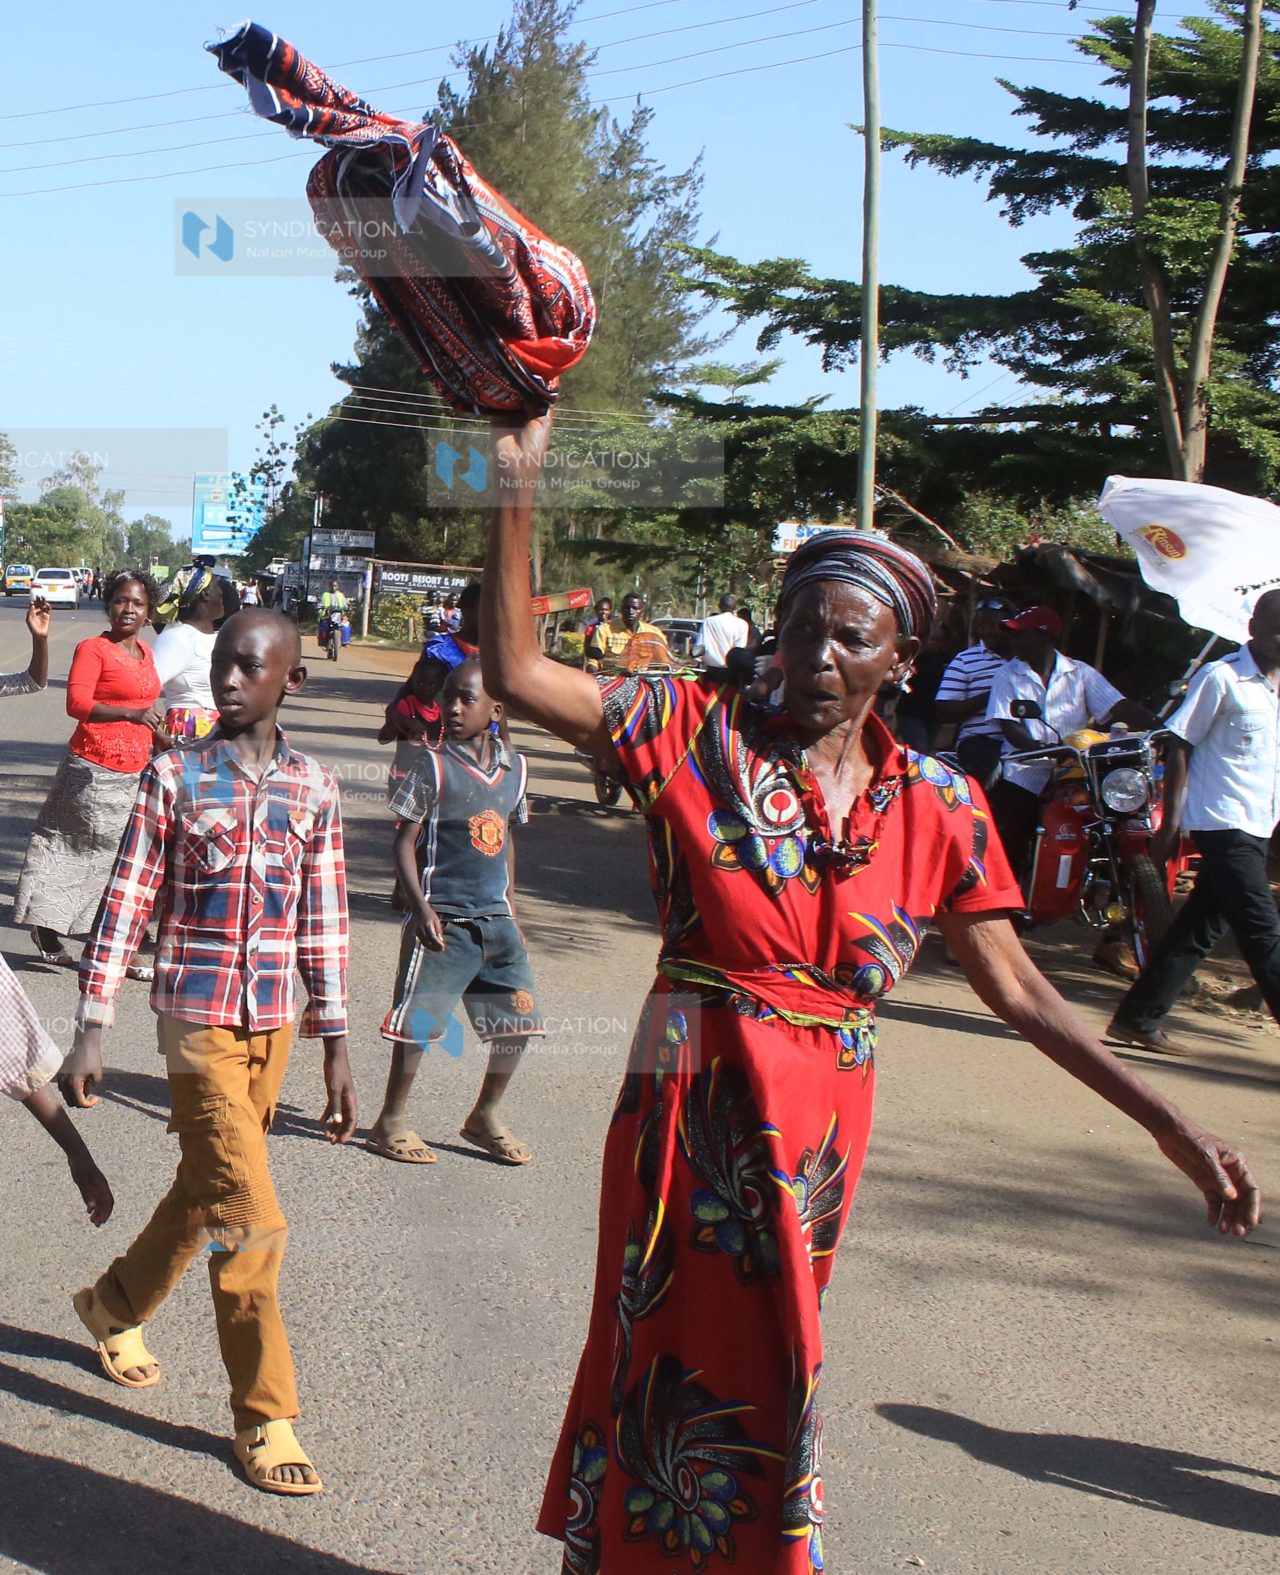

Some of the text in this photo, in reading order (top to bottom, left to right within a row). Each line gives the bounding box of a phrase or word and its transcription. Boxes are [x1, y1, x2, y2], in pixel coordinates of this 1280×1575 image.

[382, 572, 409, 582] ROOTS
[412, 574, 443, 585] RESORT
[443, 578, 450, 586] &
